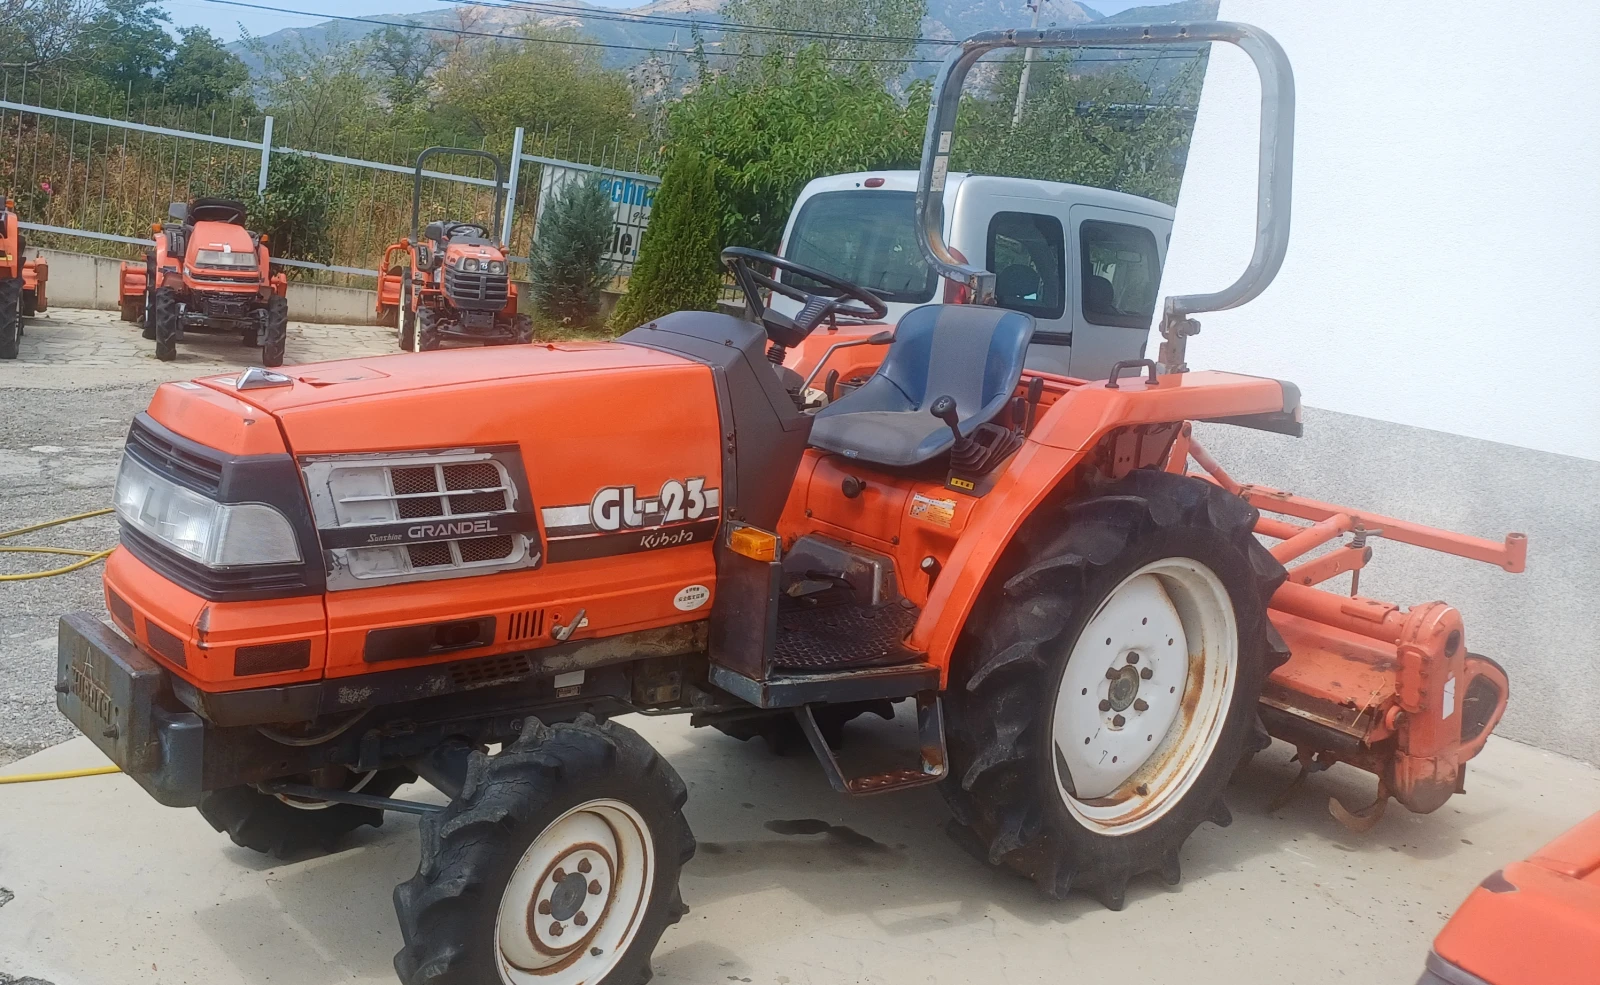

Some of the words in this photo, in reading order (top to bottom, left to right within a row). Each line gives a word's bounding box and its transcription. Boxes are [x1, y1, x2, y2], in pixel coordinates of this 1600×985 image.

[589, 477, 706, 532] GL-23
[407, 520, 499, 539] GRANDEL
[640, 529, 694, 548] Kubota
